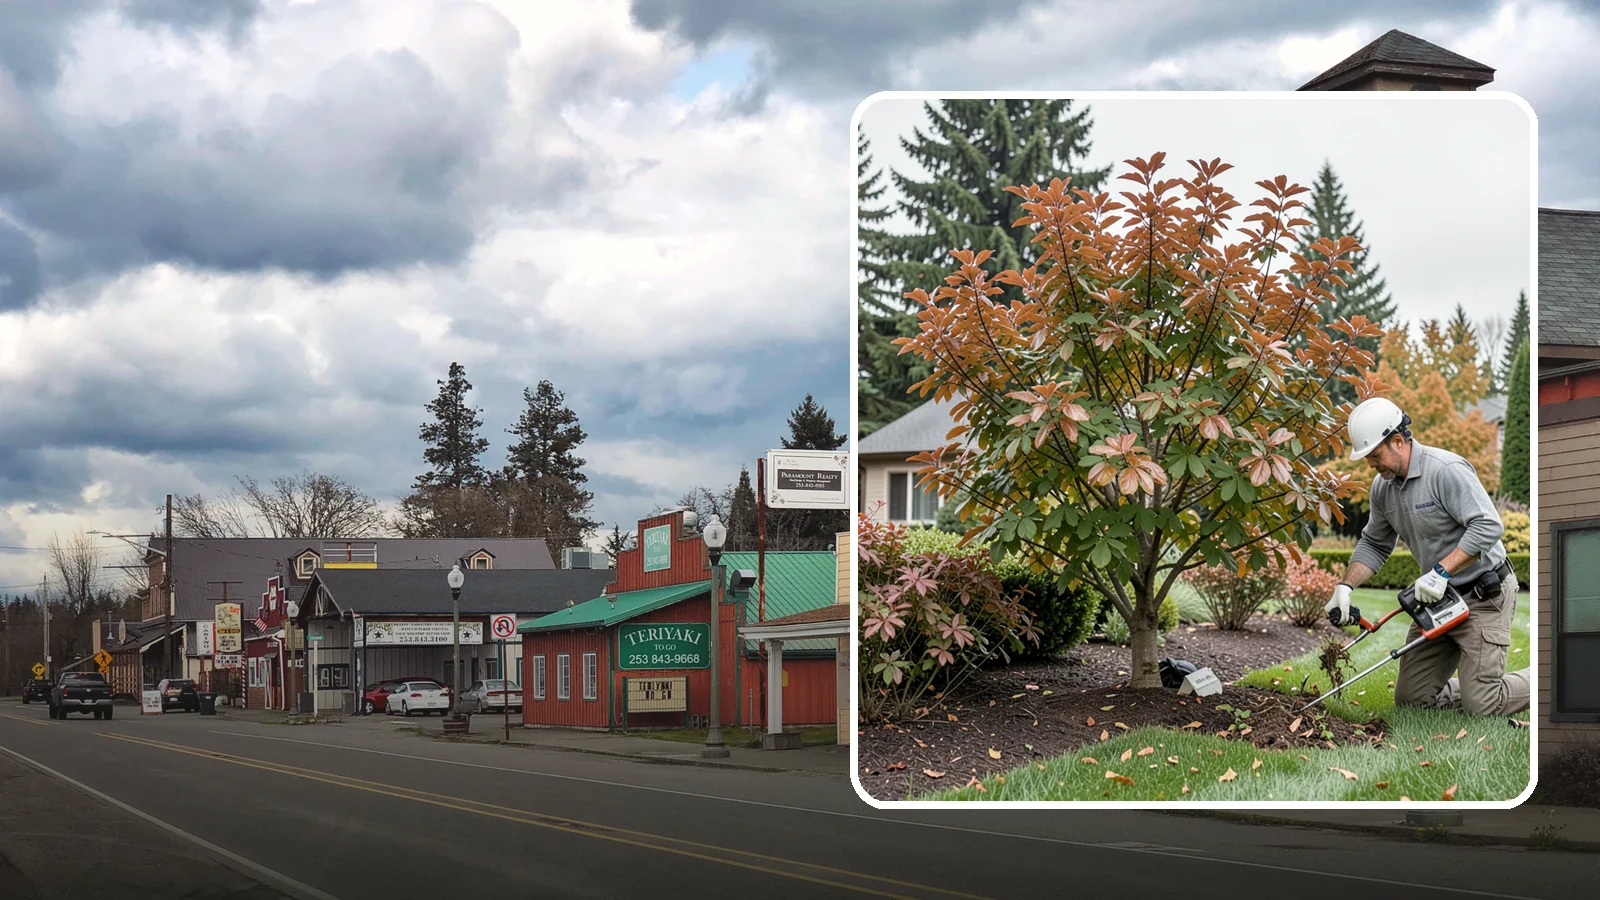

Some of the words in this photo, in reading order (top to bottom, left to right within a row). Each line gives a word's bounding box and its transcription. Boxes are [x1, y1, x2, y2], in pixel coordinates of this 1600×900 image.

[229, 606, 240, 614] Roy
[625, 627, 702, 646] TERIYAKI
[654, 643, 664, 651] TO
[665, 643, 677, 651] GO
[628, 654, 649, 664] 253
[651, 653, 700, 664] 843-9668
